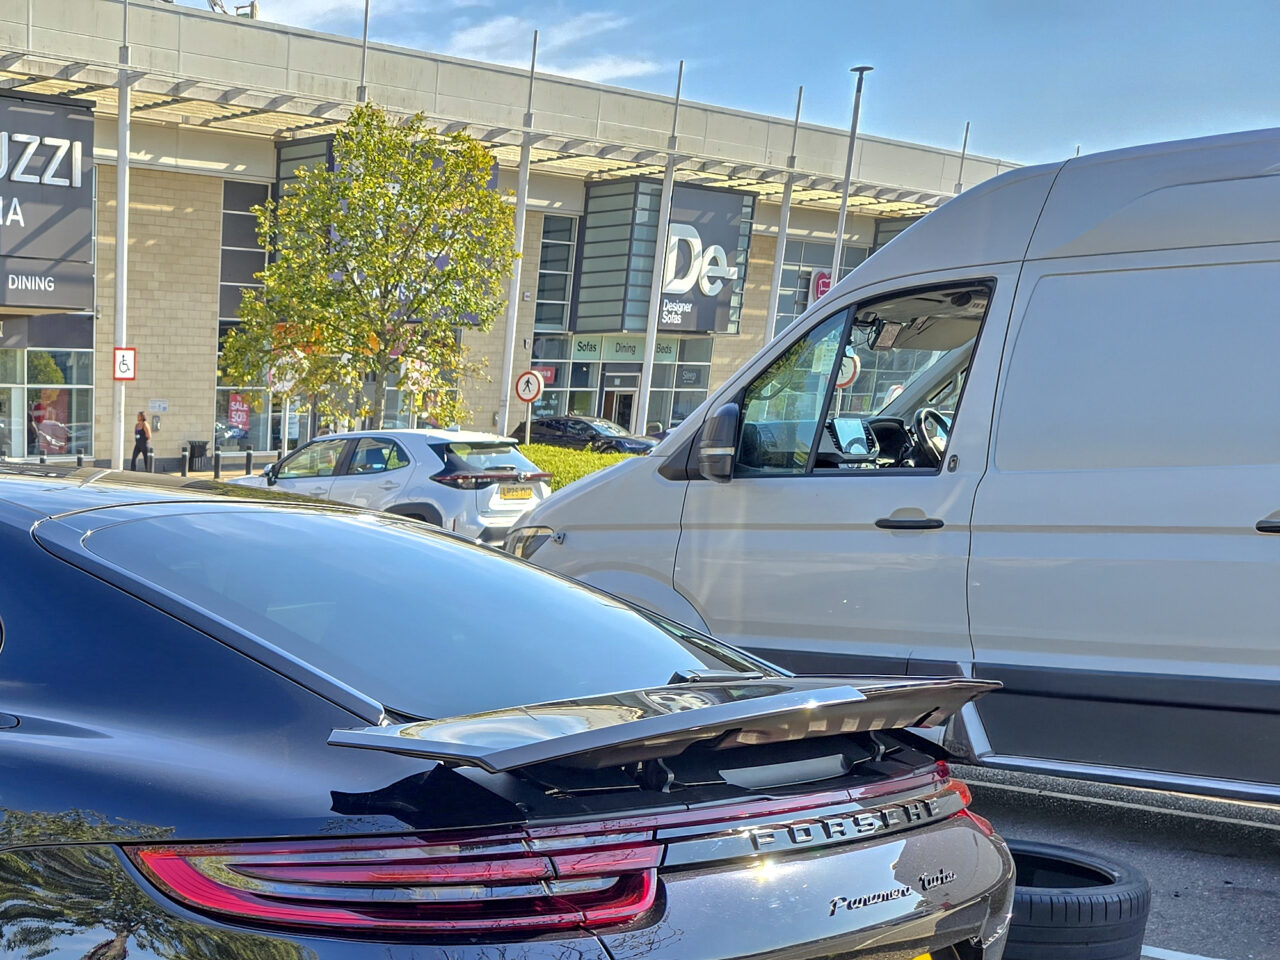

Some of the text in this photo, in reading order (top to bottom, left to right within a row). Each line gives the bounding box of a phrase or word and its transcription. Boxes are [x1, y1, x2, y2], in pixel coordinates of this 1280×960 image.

[8, 274, 55, 291] DINING
[663, 299, 692, 314] Designer
[661, 311, 682, 324] Sofas
[577, 341, 597, 353] Sofas
[615, 342, 637, 356] Dining
[656, 343, 673, 355] Beds
[231, 401, 248, 410] SALE
[751, 797, 942, 850] PORSCHE
